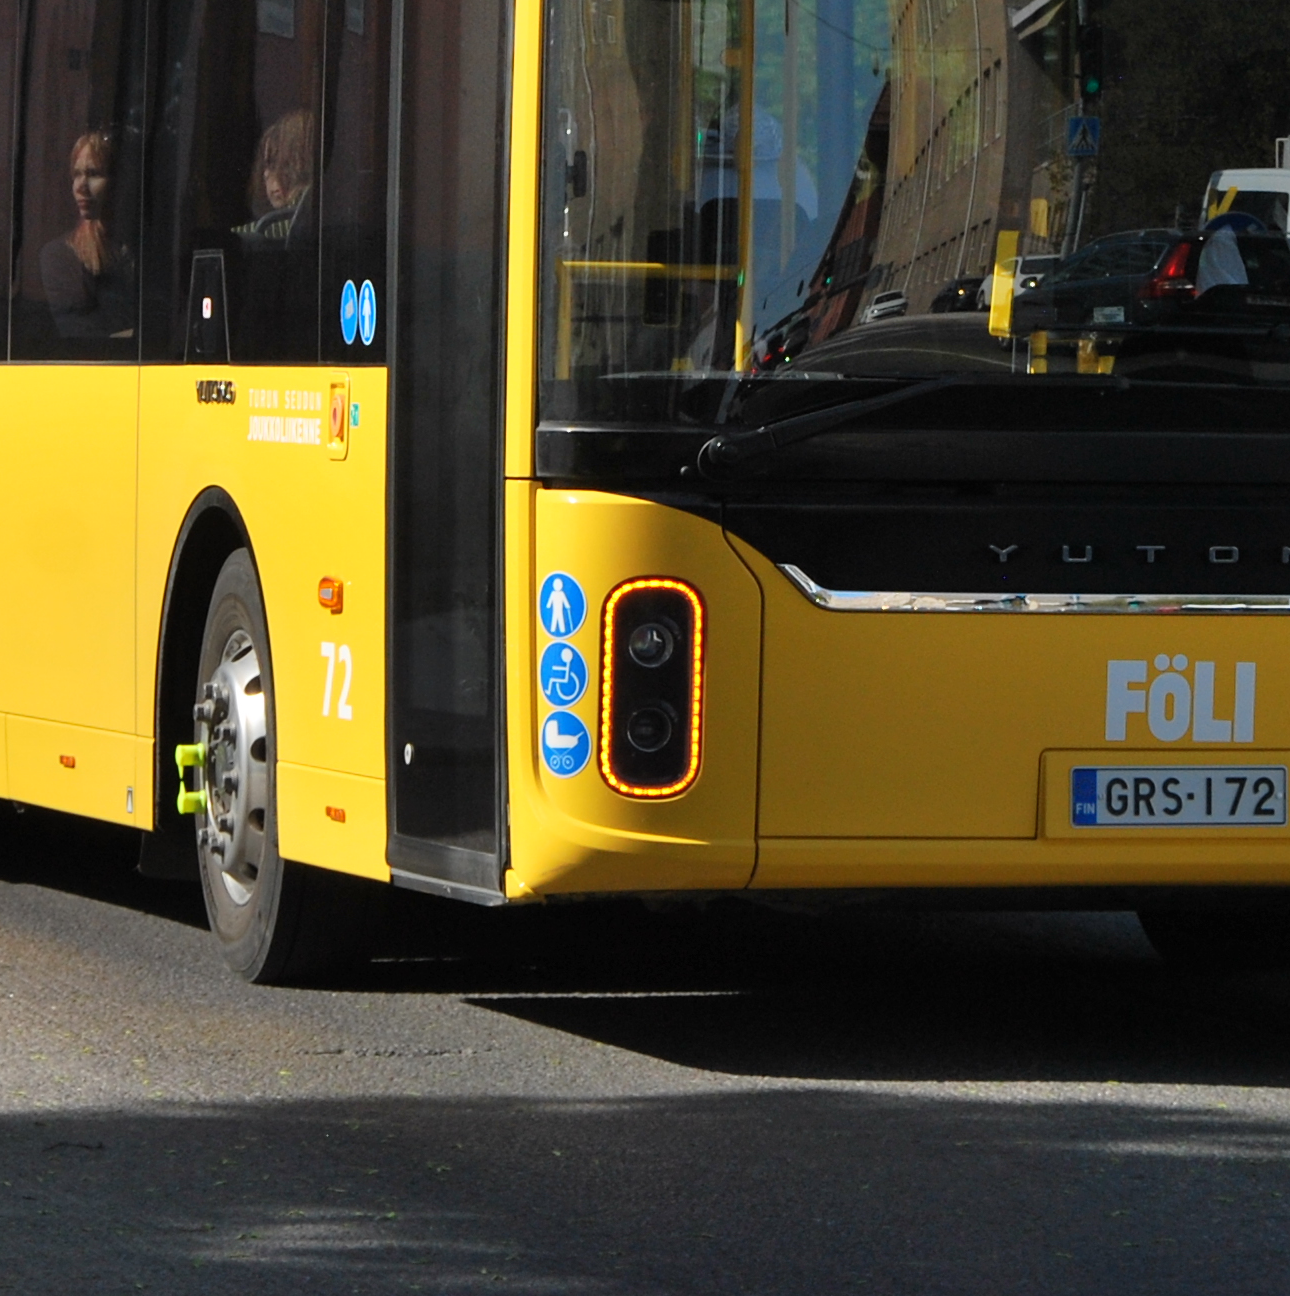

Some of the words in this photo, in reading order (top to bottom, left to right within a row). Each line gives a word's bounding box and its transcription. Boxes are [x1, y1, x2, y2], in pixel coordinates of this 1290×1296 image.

[248, 388, 279, 409] TURUN
[284, 390, 322, 411] SEUDUN
[320, 640, 353, 721] 72
[1105, 653, 1257, 743] FÖLI
[1075, 802, 1096, 815] FIN
